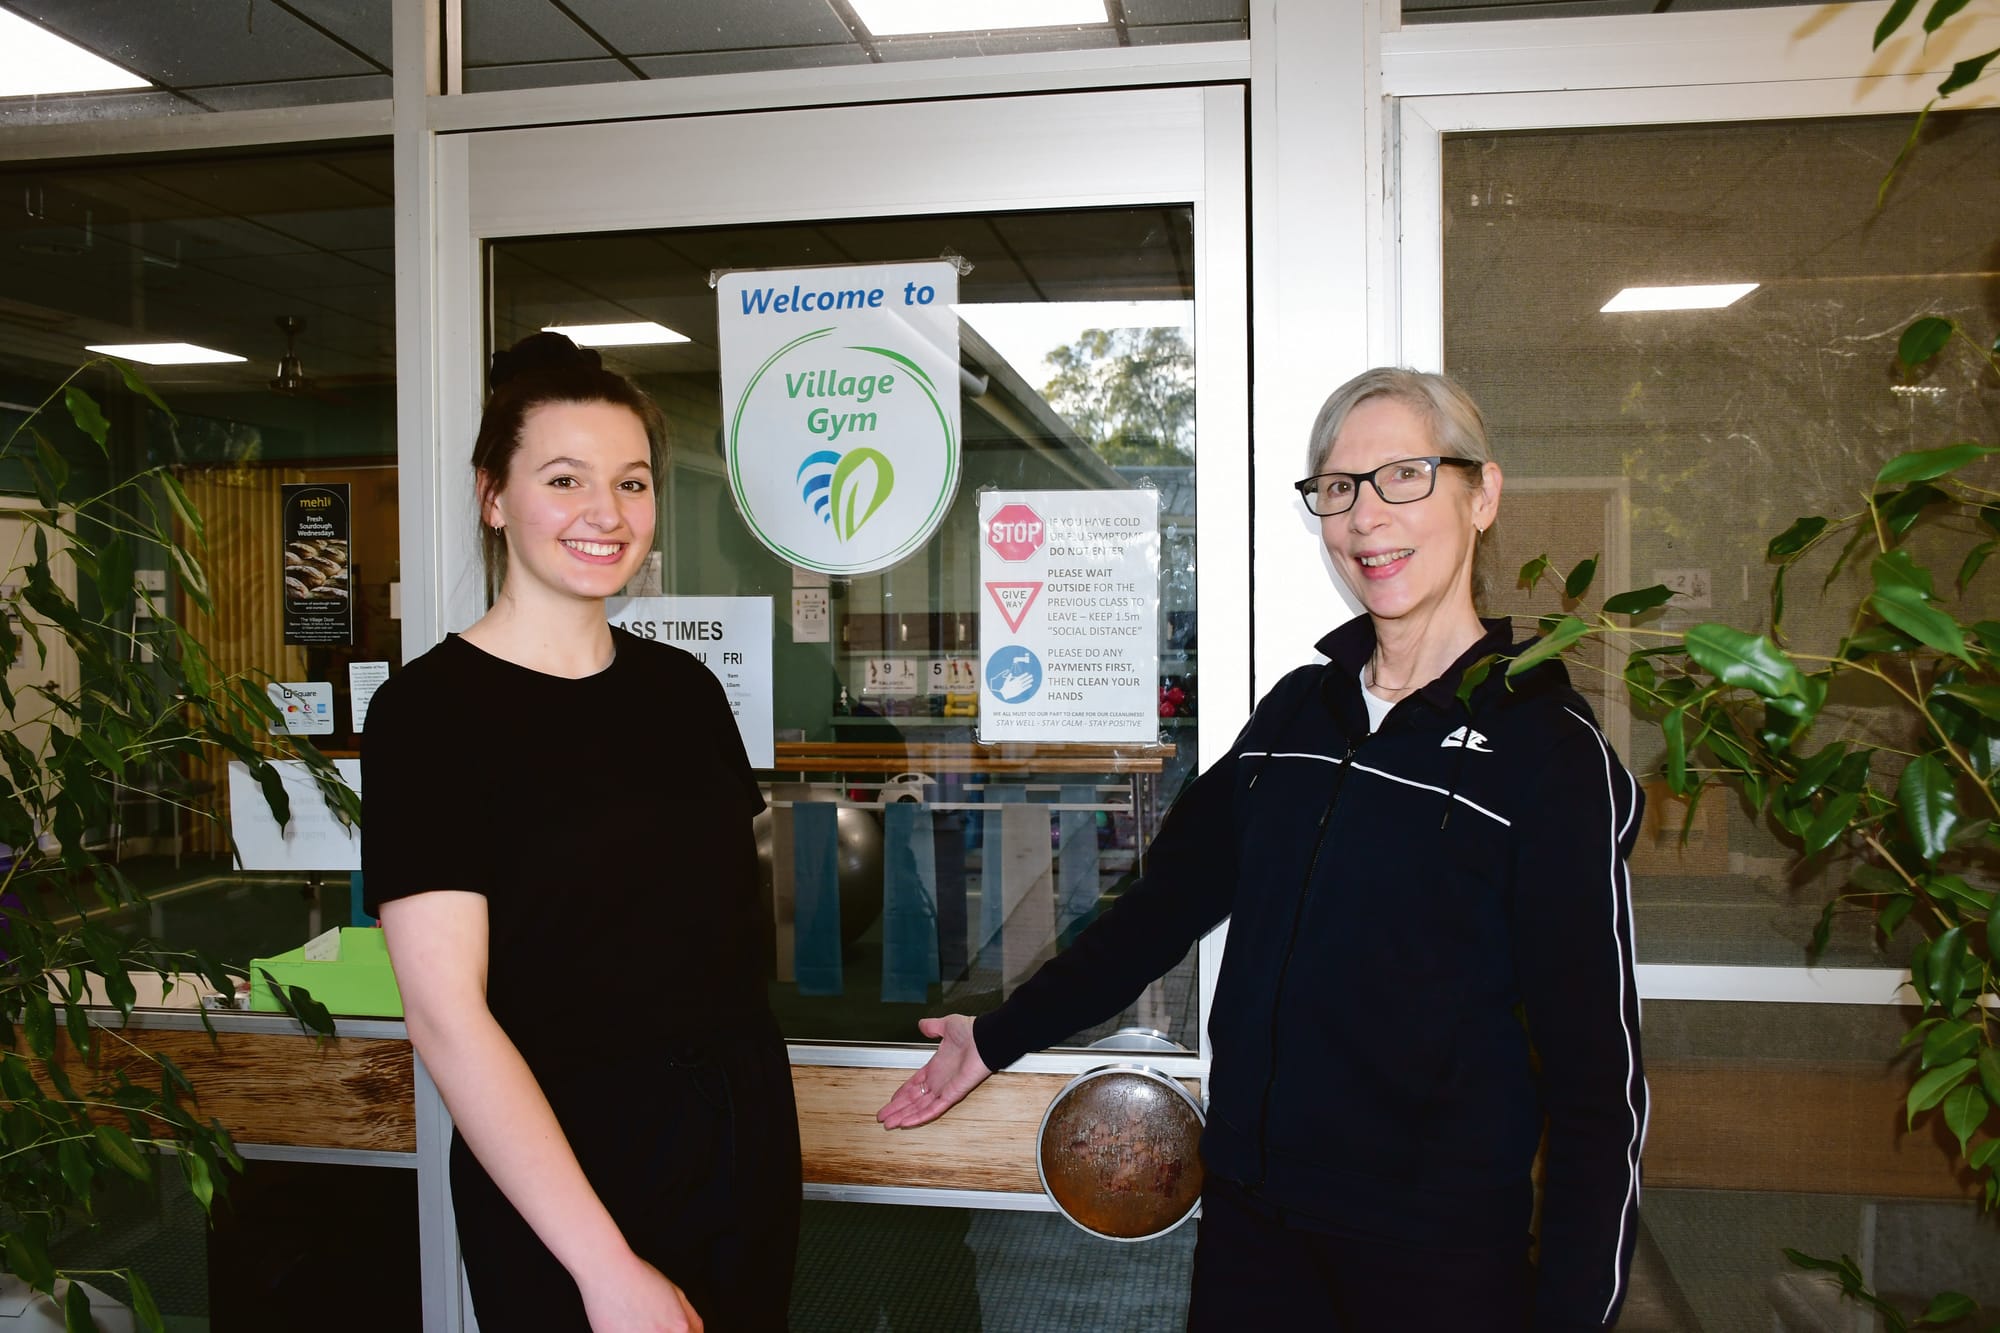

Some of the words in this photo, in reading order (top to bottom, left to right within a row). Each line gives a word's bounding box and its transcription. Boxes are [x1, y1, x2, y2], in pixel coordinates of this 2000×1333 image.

[740, 285, 884, 315] Welcome
[903, 281, 935, 306] to
[785, 369, 895, 403] Village
[807, 408, 877, 441] Gym
[1062, 518, 1082, 526] YOU
[1085, 518, 1111, 526] HAVE
[1114, 518, 1140, 526] COLD
[991, 522, 1042, 544] STOP
[1067, 532, 1084, 542] FU
[1050, 547, 1064, 556] DO
[1068, 547, 1089, 556] NOT
[1092, 546, 1124, 556] ENER
[1048, 568, 1082, 578] PLEASE
[1086, 568, 1112, 578] WAIT
[1048, 584, 1091, 592] OUTSIDE
[1094, 584, 1114, 592] FOR
[1116, 584, 1135, 592] THE
[1002, 590, 1027, 600] GIVE
[1006, 600, 1024, 608] WAY
[1048, 598, 1096, 606] PREVIOUS
[1099, 598, 1128, 606] CLASS
[1132, 598, 1144, 606] TO
[1048, 612, 1077, 622] LEAVE
[1088, 612, 1112, 622] KEEP
[1116, 612, 1140, 622] 1.5m
[620, 621, 656, 640] ASS
[662, 621, 723, 640] TIMES
[723, 652, 742, 664] FRI
[1048, 648, 1082, 658] PLEASE
[1086, 648, 1100, 658] DO
[1103, 648, 1124, 658] ANY
[884, 663, 892, 674] 9
[933, 663, 942, 675] 5
[1048, 663, 1102, 672] PAYMENTS
[1105, 663, 1135, 673] FIRST,
[1048, 678, 1074, 686] THEN
[1076, 678, 1108, 686] CLEAN
[1112, 678, 1140, 686] YOUR
[1048, 692, 1084, 700] HANDS
